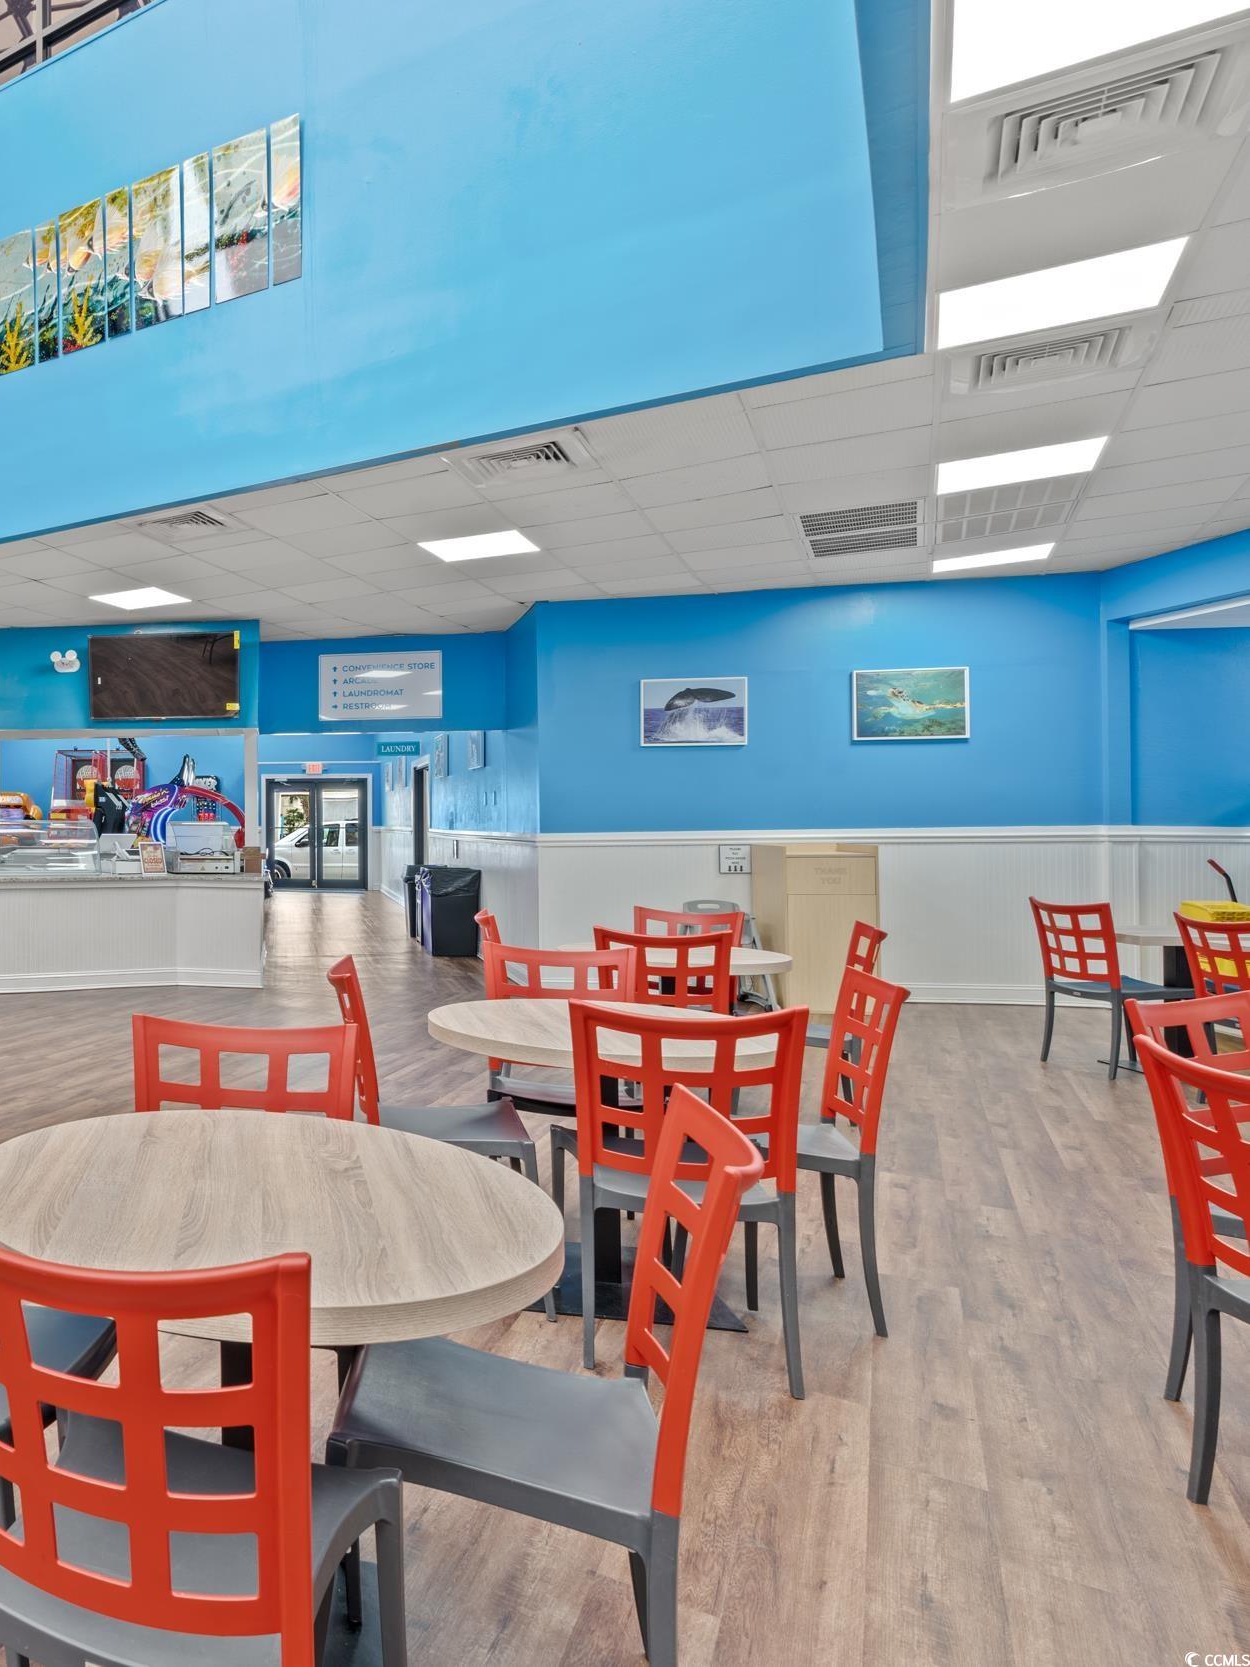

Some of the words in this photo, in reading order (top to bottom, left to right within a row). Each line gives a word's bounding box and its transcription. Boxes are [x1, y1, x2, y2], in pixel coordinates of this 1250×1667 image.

[407, 662, 436, 670] STORE
[342, 688, 405, 697] LAUNDROMAT
[381, 745, 415, 753] LAUNDRY
